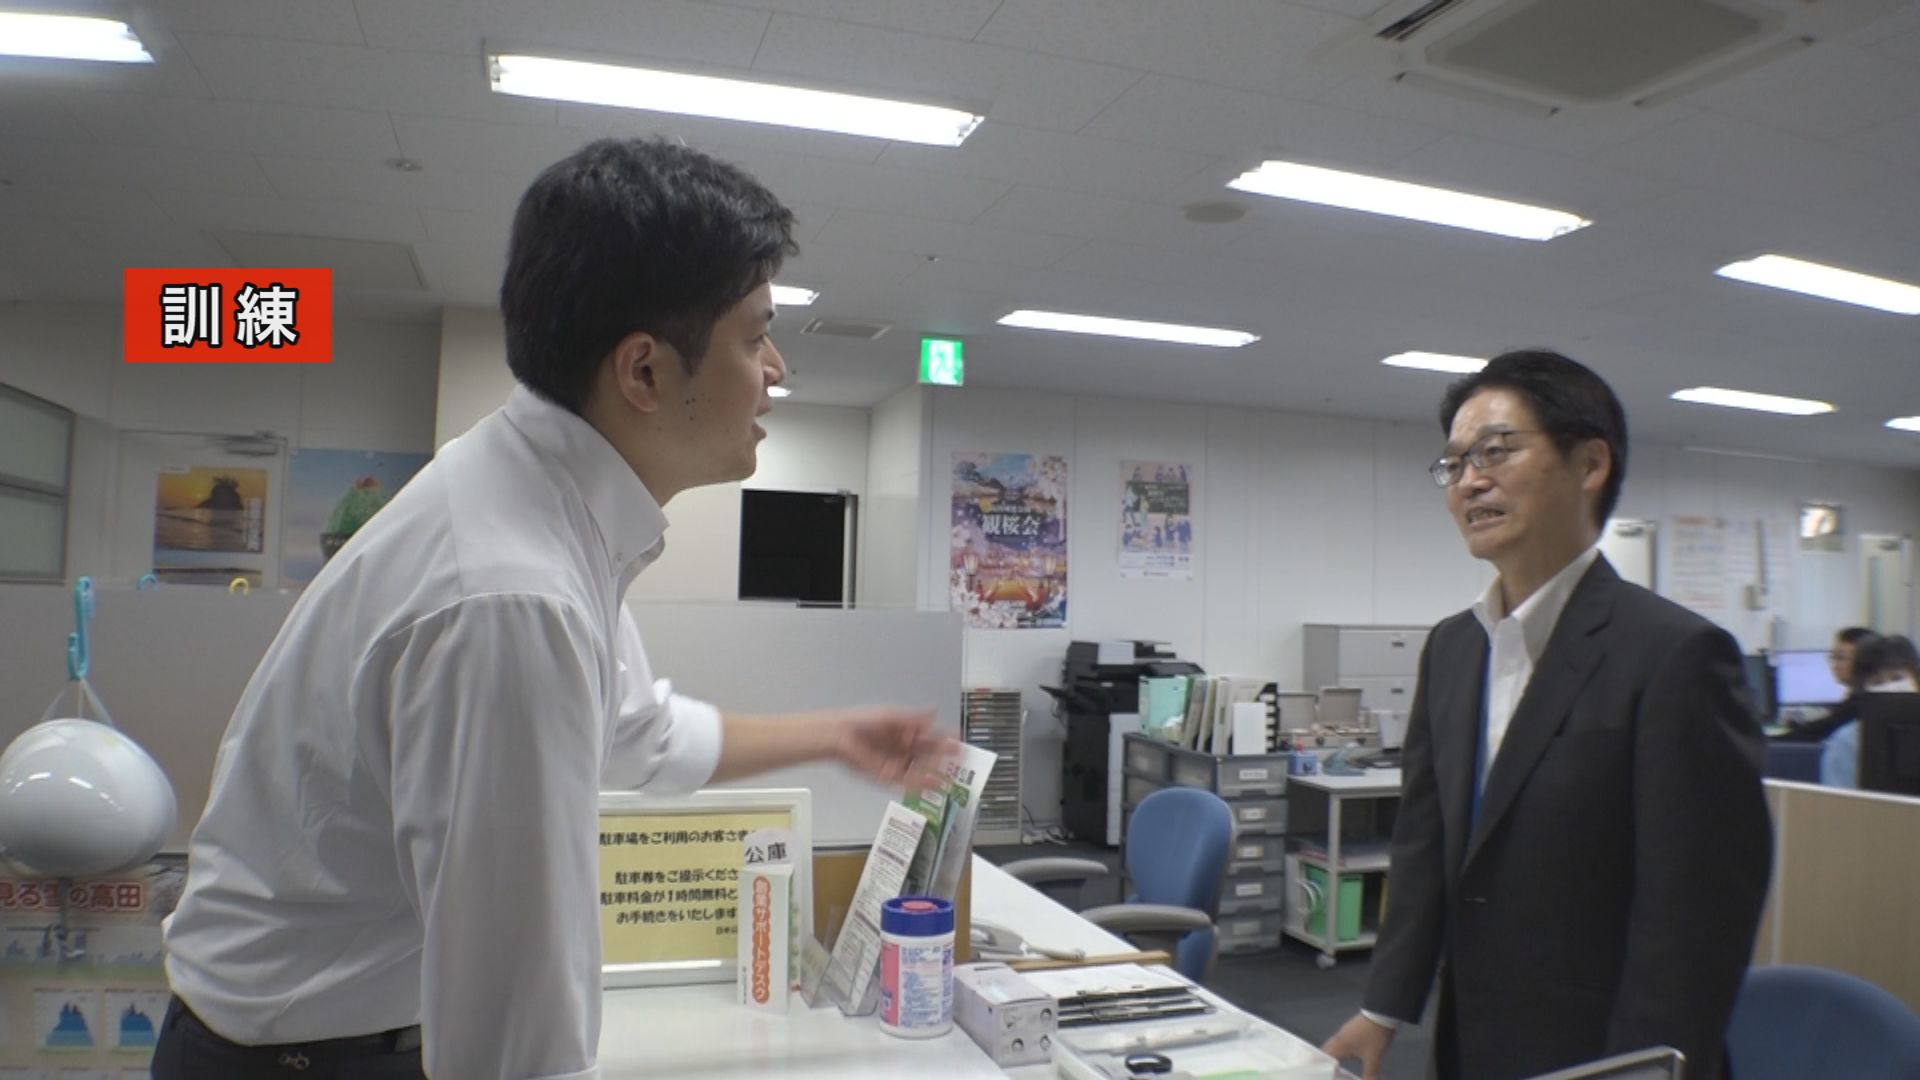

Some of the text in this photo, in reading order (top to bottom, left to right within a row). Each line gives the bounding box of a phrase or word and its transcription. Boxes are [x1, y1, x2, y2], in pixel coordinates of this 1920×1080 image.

[982, 513, 1040, 536] 観桜会
[600, 830, 756, 847] 駐車場をご利用のお客さま
[744, 841, 787, 865] 公庫
